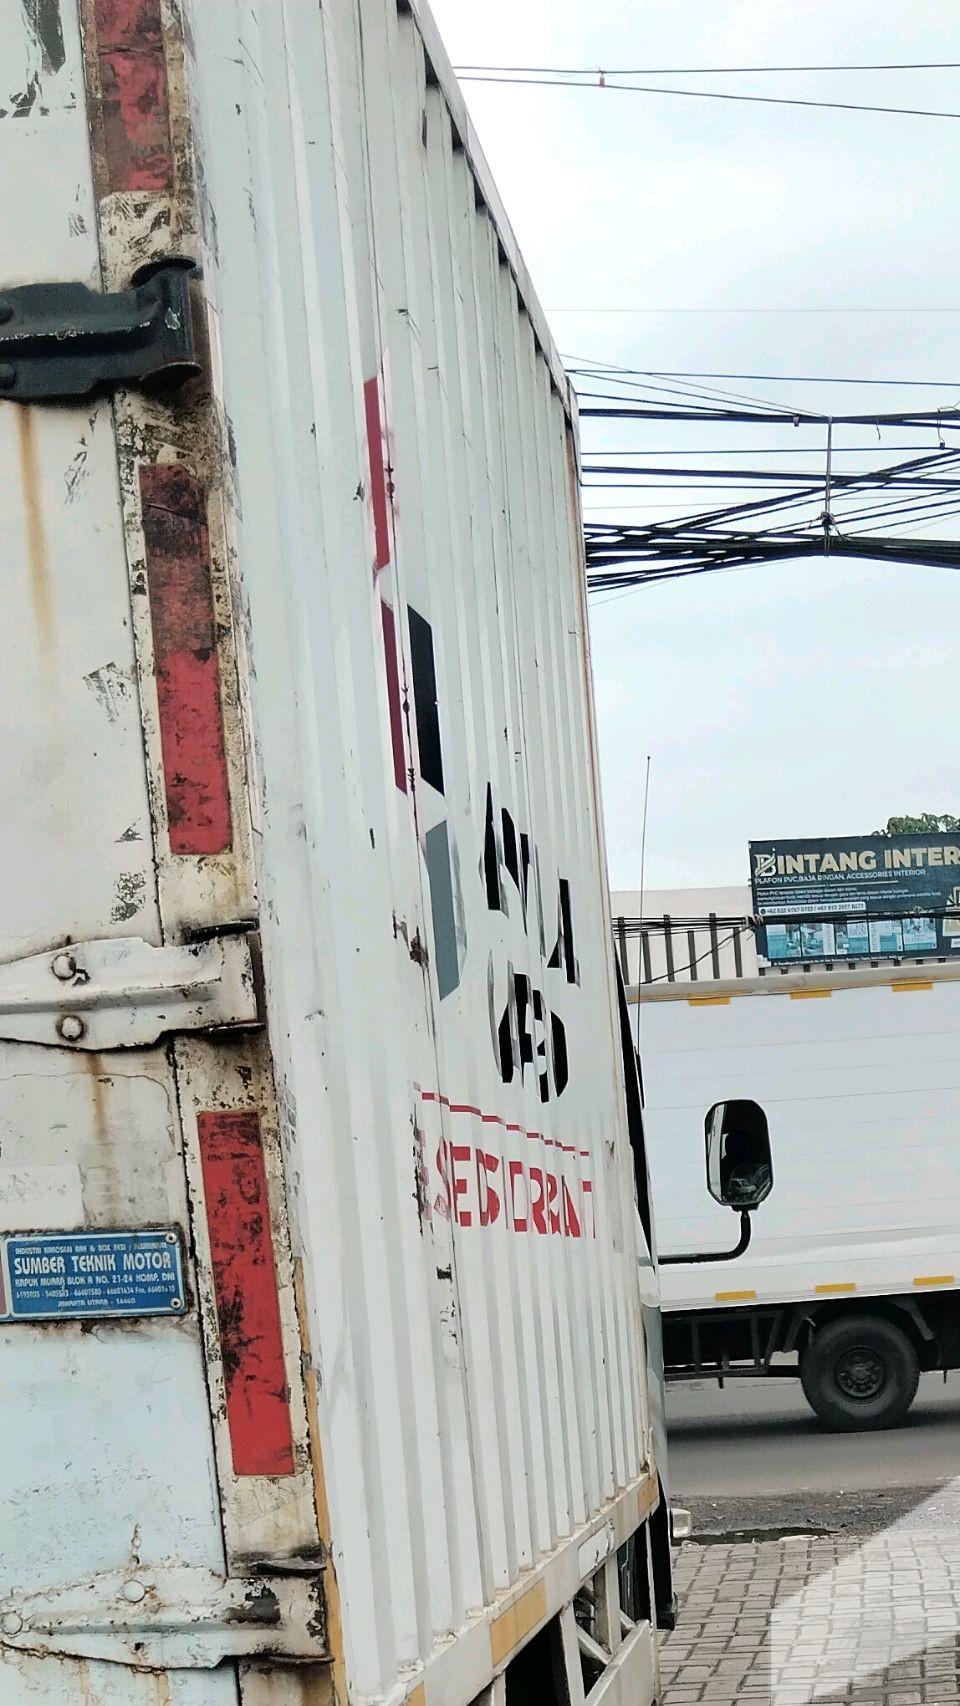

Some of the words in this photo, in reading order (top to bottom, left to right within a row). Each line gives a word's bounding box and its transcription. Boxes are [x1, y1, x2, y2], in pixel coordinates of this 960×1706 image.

[755, 848, 877, 877] BINTANG
[894, 868, 926, 877] INTERIOR
[14, 1256, 66, 1275] SUMBER
[71, 1253, 117, 1272] TEKNIK
[123, 1251, 172, 1271] MOTOR
[67, 1276, 86, 1285] BLOK
[95, 1274, 110, 1284] NO.
[112, 1273, 133, 1284] 21-24
